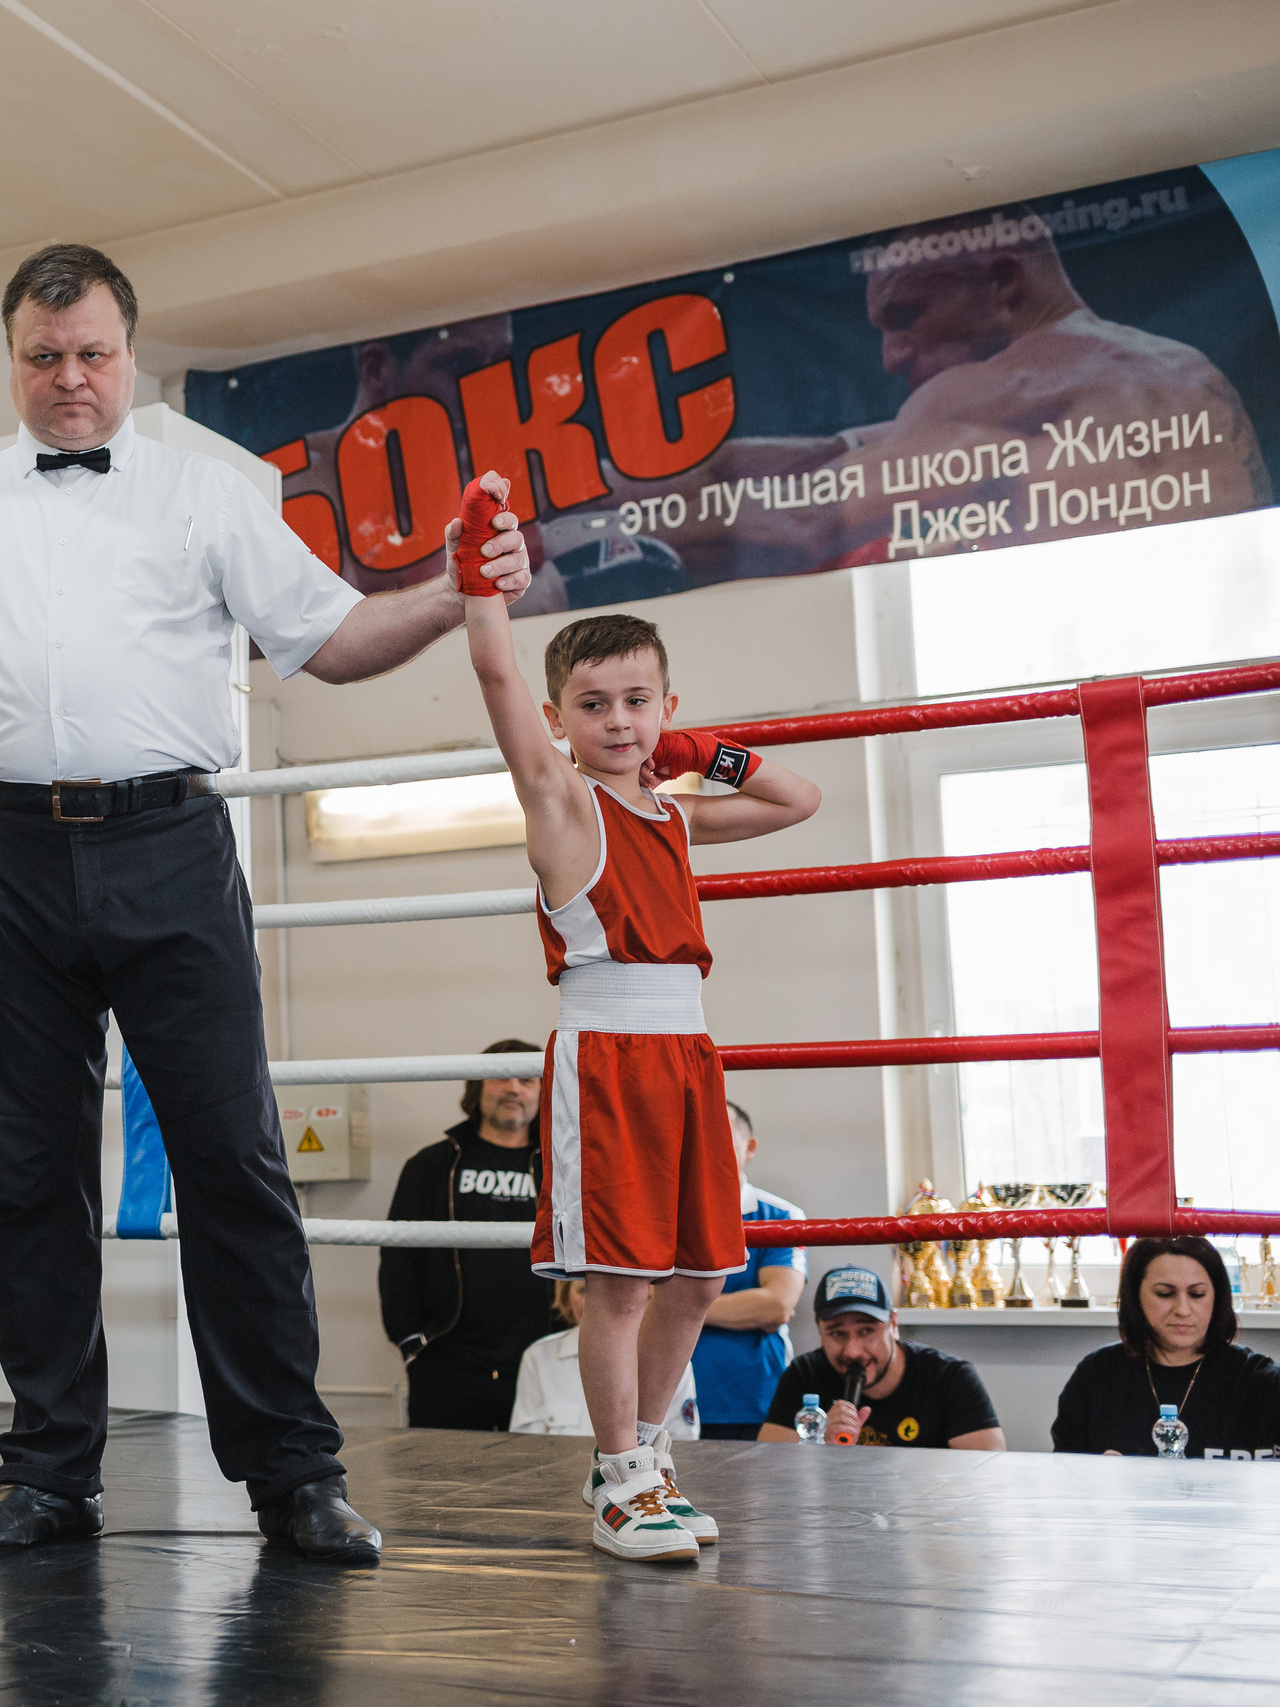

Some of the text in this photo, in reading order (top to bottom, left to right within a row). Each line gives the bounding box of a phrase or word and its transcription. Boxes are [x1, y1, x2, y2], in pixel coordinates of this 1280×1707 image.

[850, 186, 1189, 275] moscowboxing.ru
[619, 492, 687, 536] это
[697, 463, 866, 528] лучшая
[881, 438, 1030, 496] школа
[1042, 409, 1224, 471] Жизни.
[887, 468, 1212, 560] Джек Лондон
[458, 1169, 537, 1198] BOXIN
